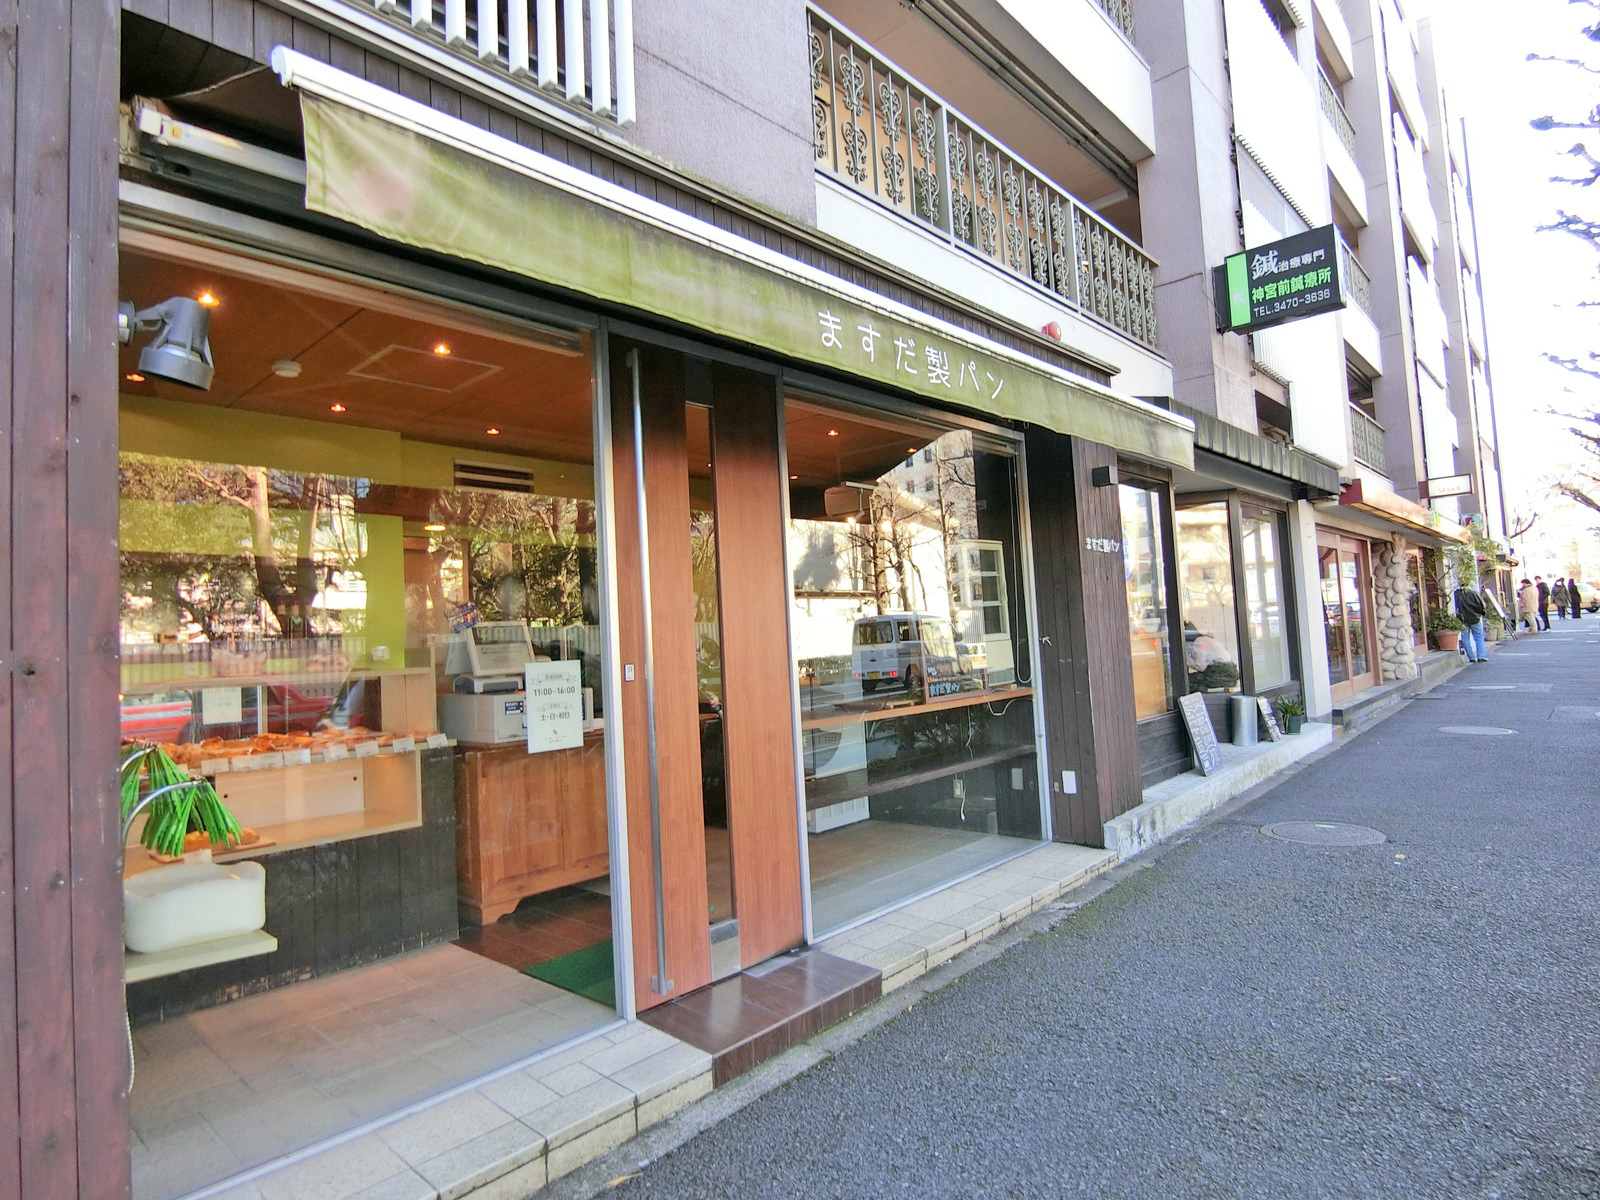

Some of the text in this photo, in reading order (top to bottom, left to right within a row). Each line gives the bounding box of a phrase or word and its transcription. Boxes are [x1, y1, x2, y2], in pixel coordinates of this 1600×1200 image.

[1251, 267, 1332, 304] 神宮前鍼療所
[818, 309, 1005, 399] ますだ製パン
